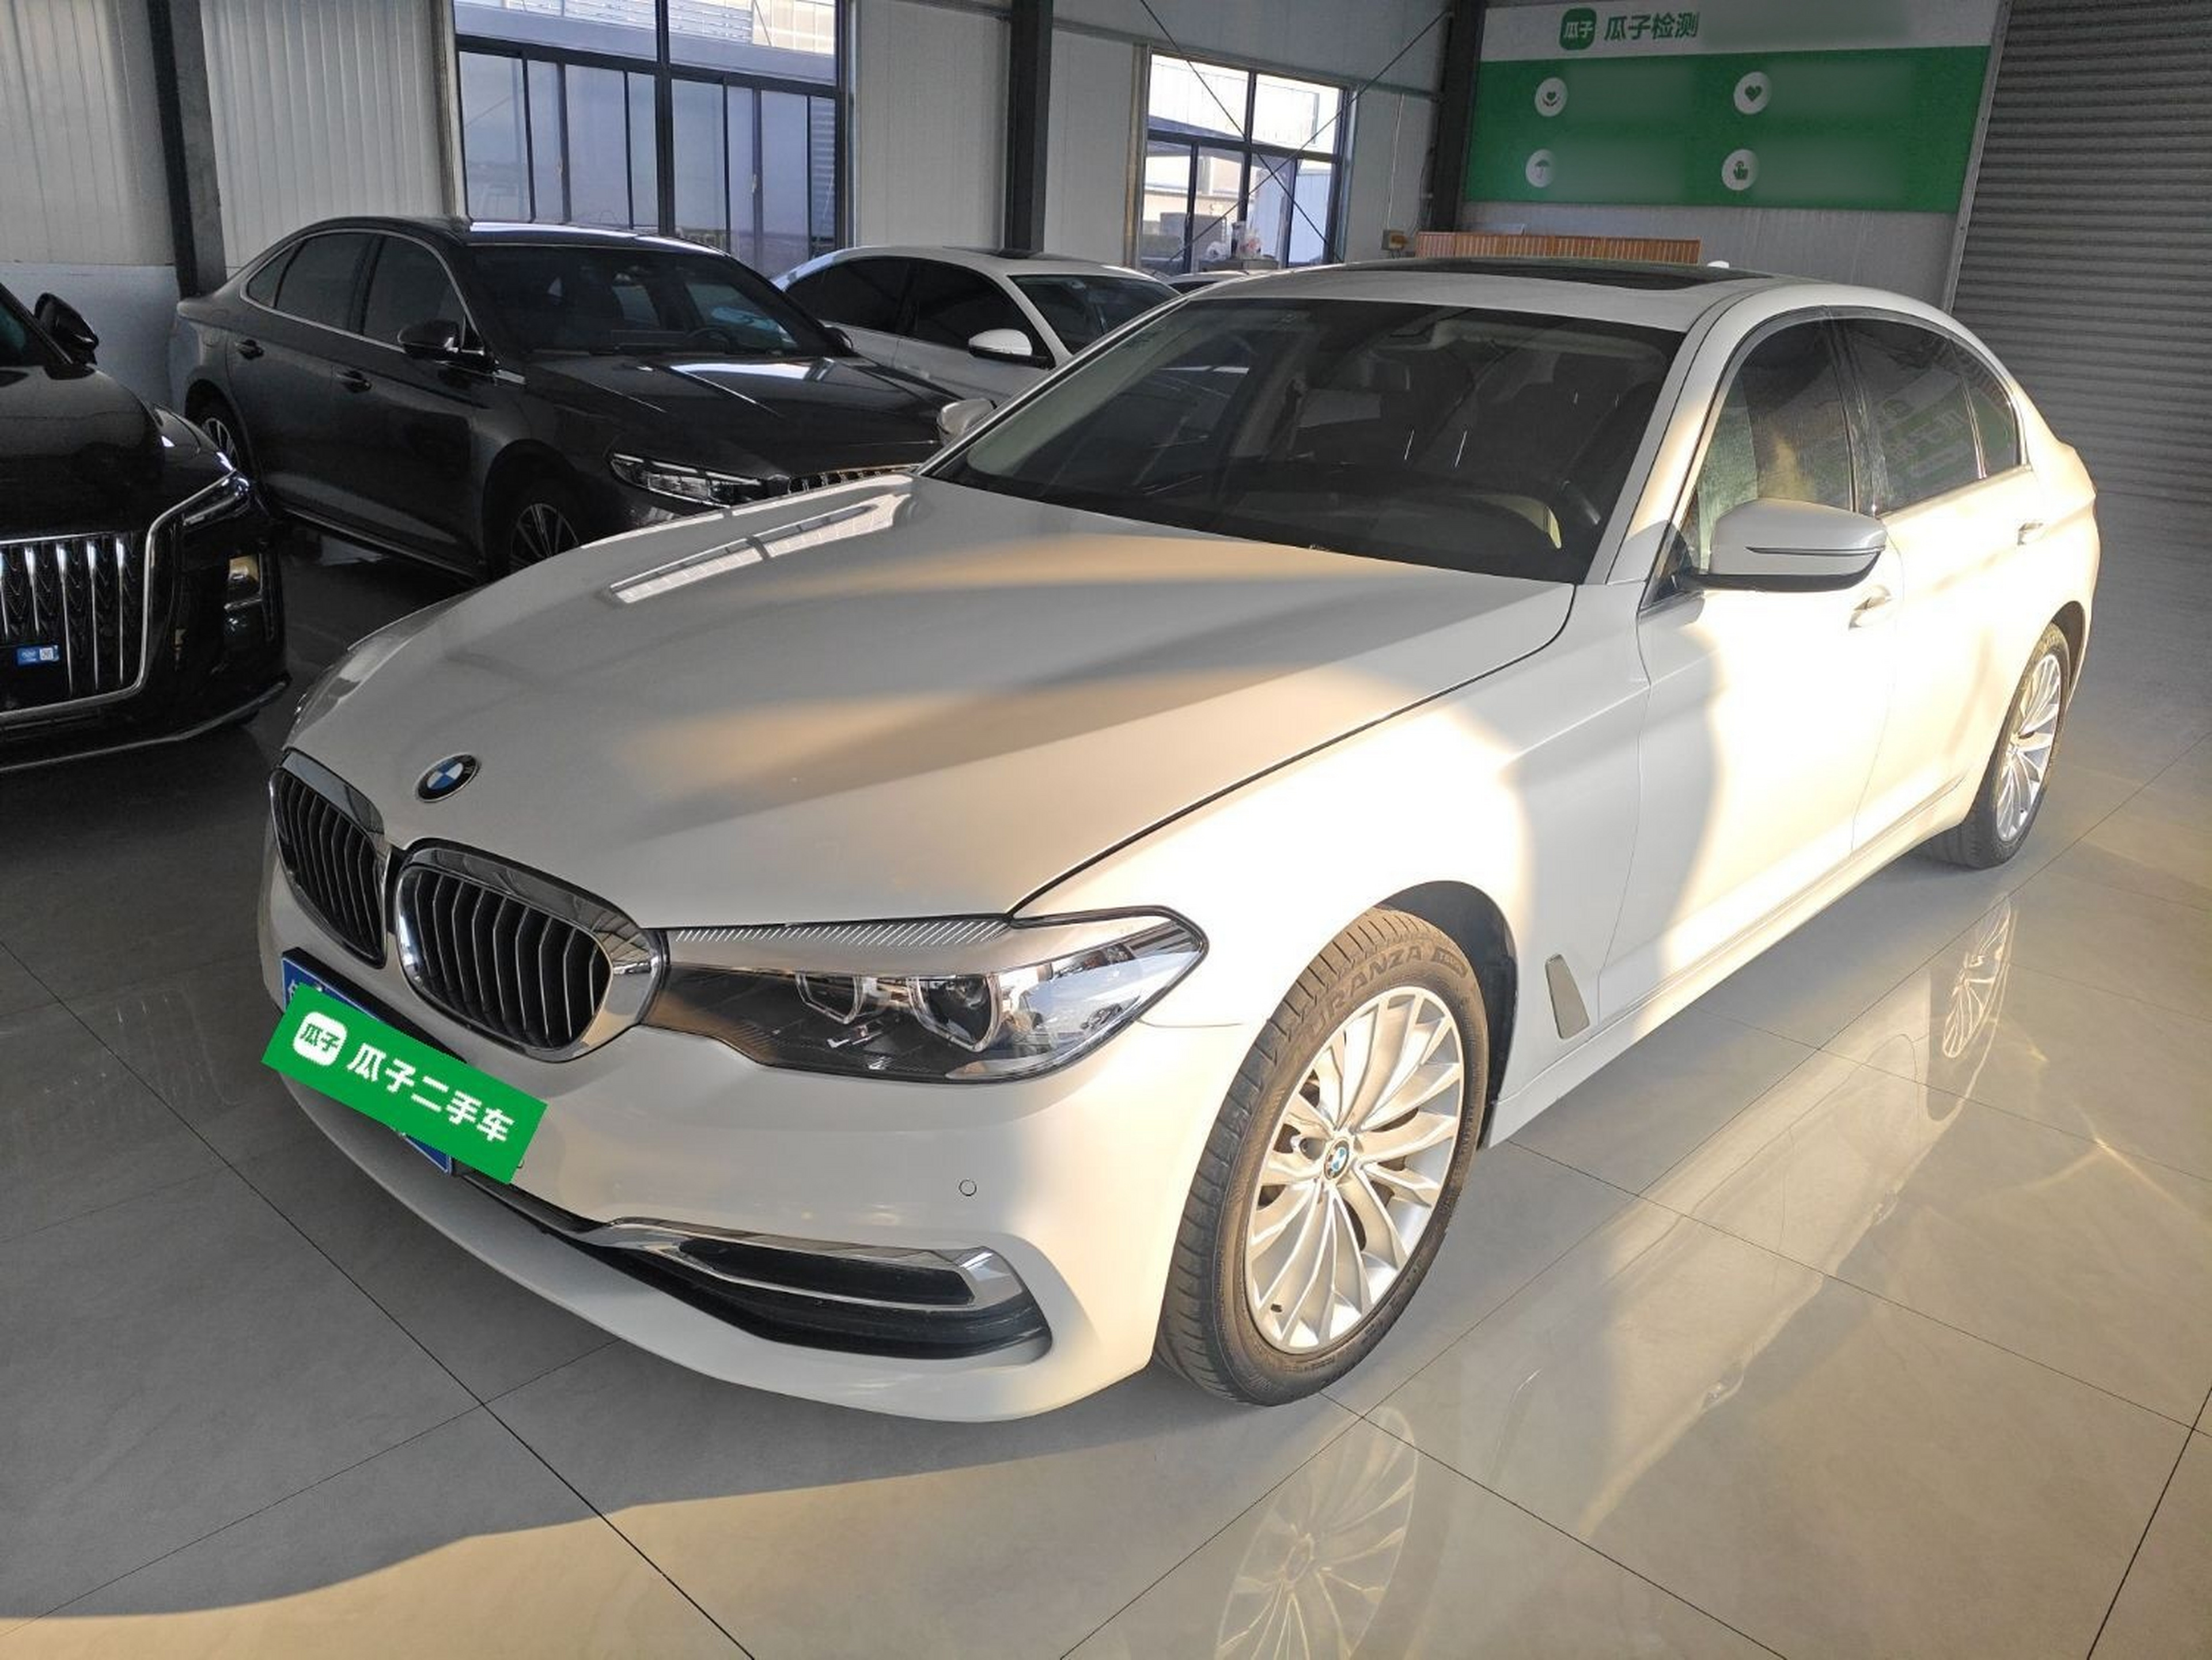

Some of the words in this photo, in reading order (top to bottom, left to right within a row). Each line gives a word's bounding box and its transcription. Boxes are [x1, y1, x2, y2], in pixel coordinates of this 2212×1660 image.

[1563, 20, 1593, 39] 瓜子
[1604, 12, 1700, 41] 瓜子检测
